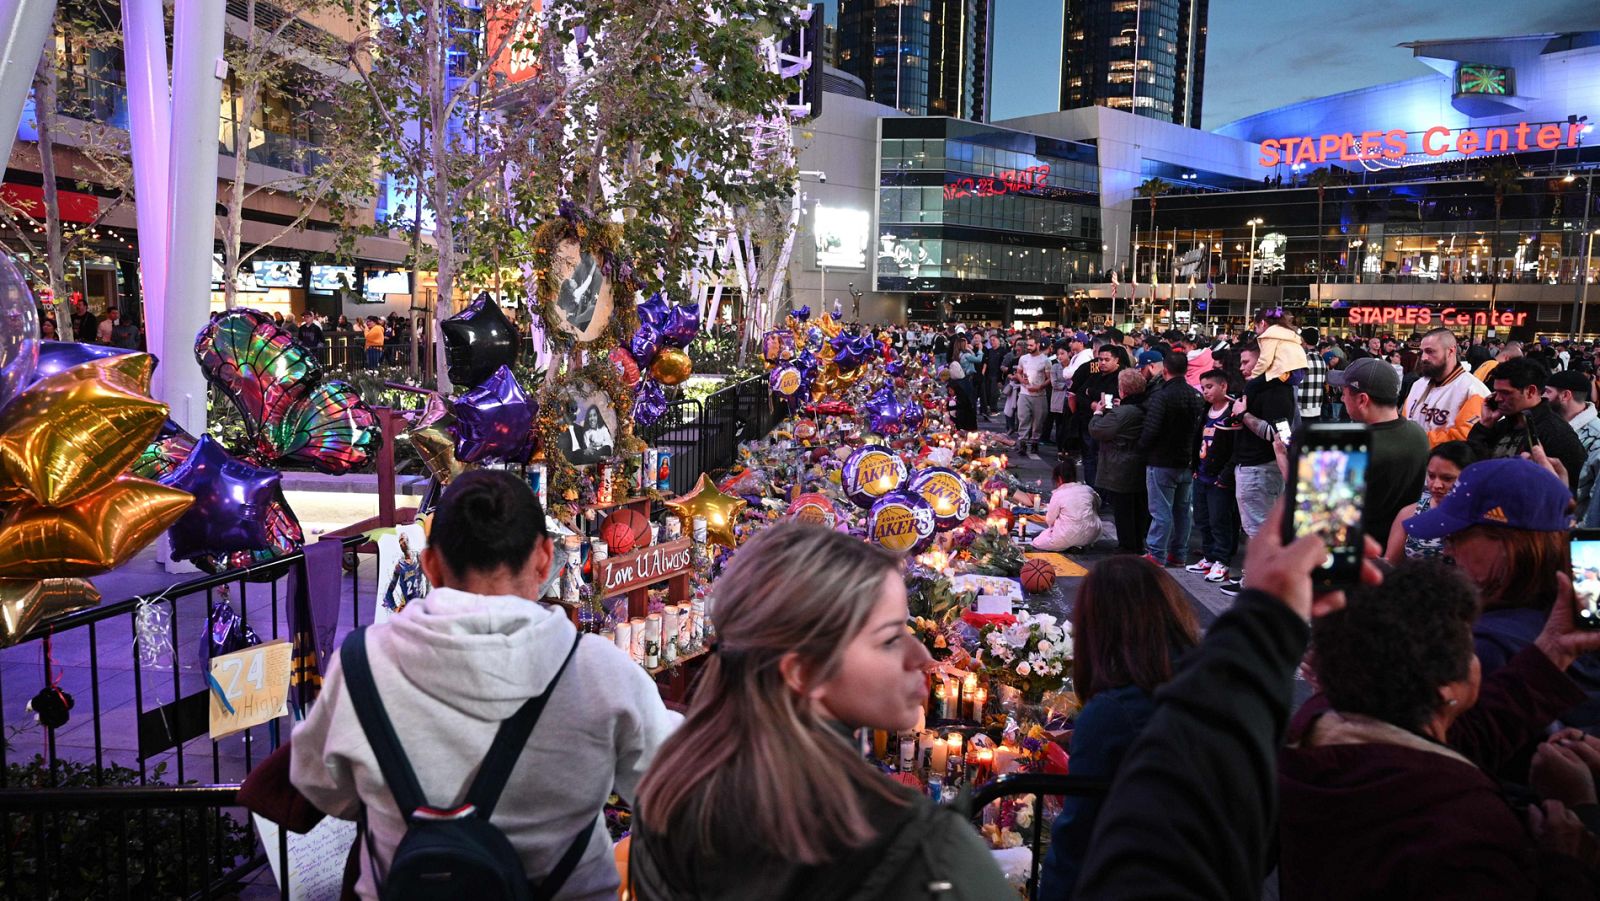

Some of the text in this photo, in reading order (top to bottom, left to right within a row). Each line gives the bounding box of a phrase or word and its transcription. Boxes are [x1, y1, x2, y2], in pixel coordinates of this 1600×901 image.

[1258, 120, 1583, 168] STAPLES Center
[1349, 306, 1527, 326] STAPLES Center
[874, 517, 929, 542] LAKERS
[605, 547, 690, 589] Love U Always
[221, 648, 266, 700] 24
